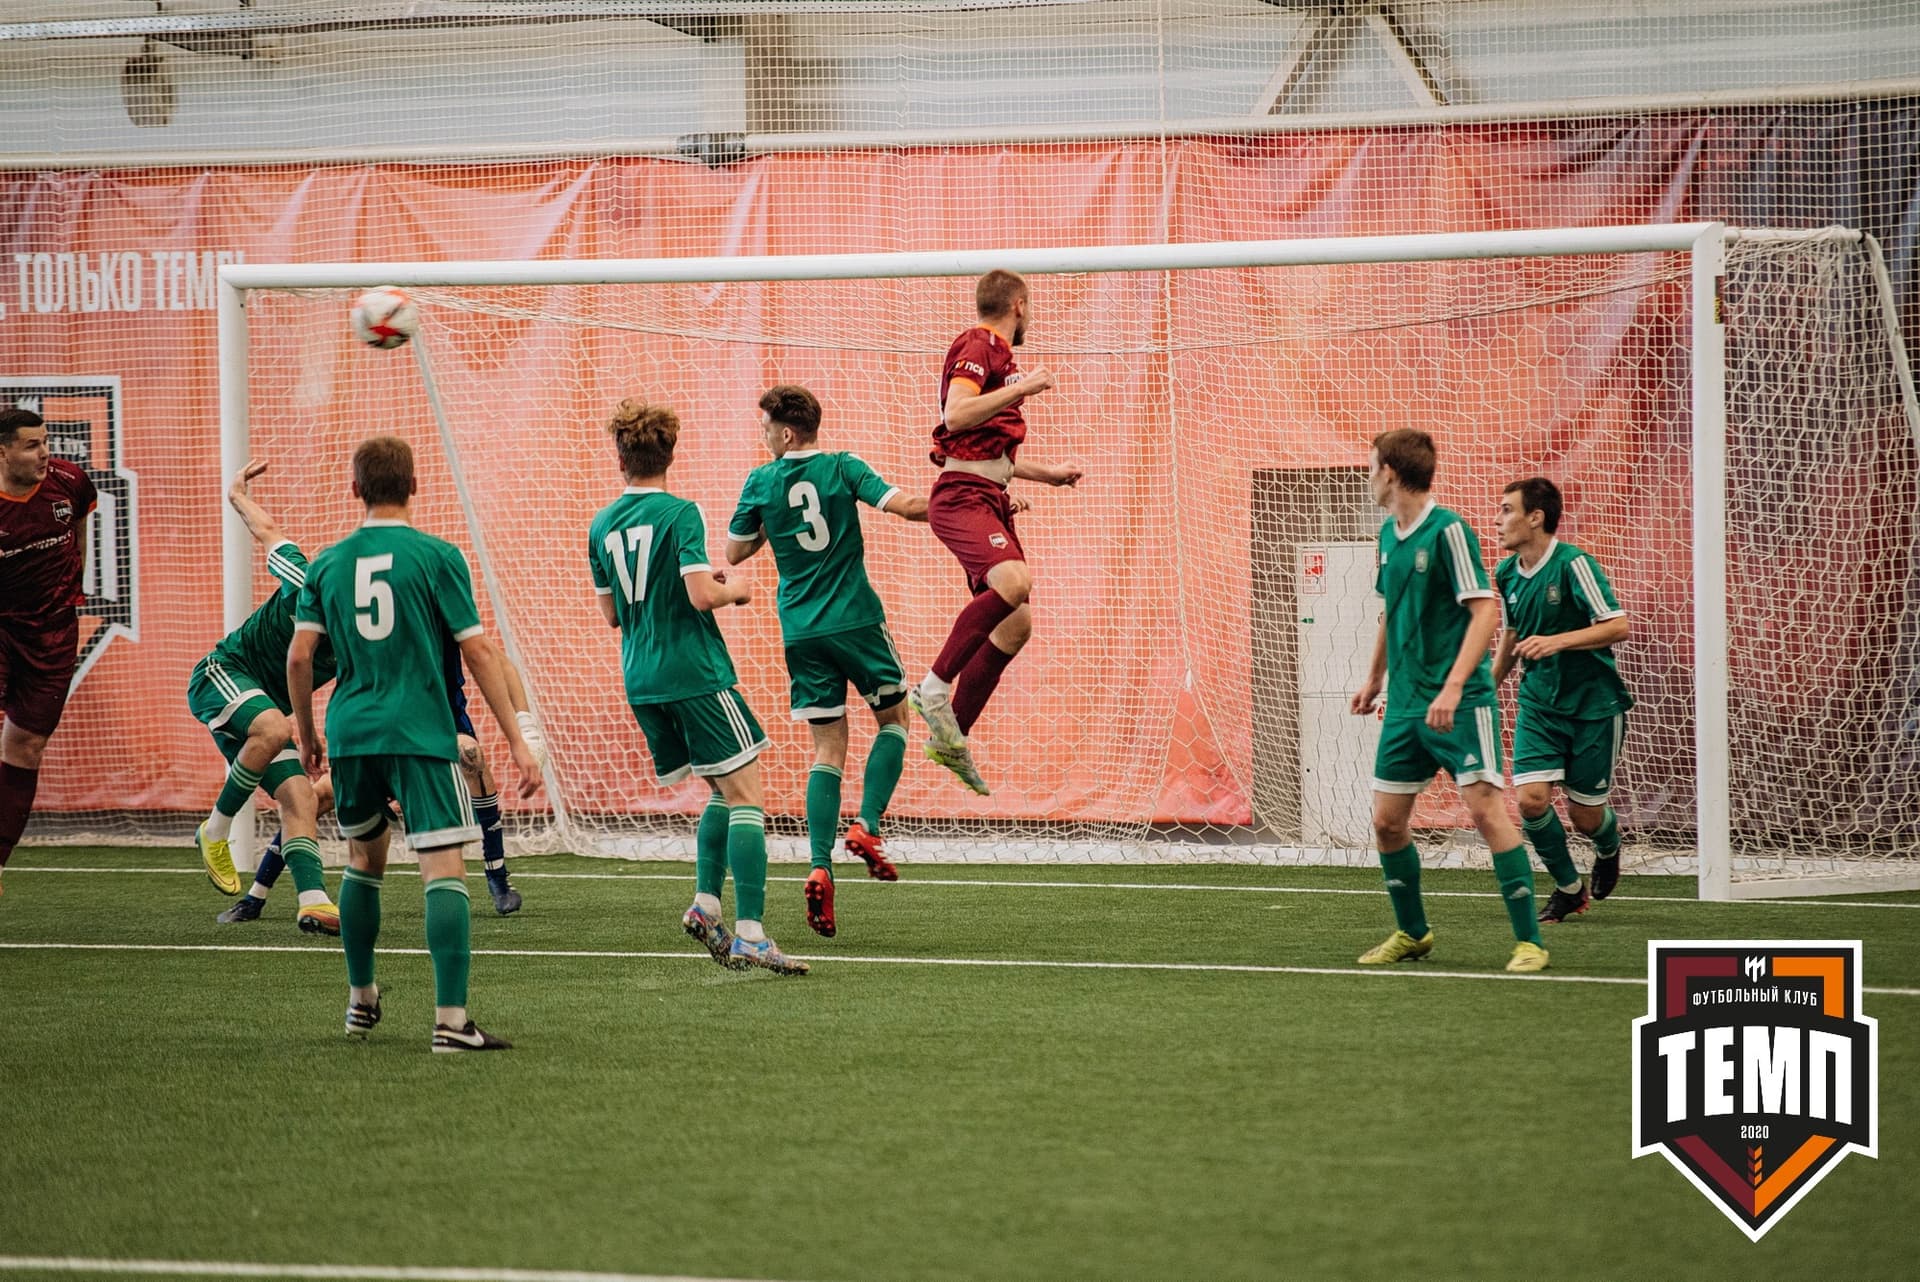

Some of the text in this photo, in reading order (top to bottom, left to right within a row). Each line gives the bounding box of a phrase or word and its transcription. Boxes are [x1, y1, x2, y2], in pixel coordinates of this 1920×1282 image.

[15, 251, 245, 313] ТОЛЬКО ТЕМ
[788, 481, 830, 552] 3
[354, 553, 396, 642] 5
[604, 524, 653, 605] 17
